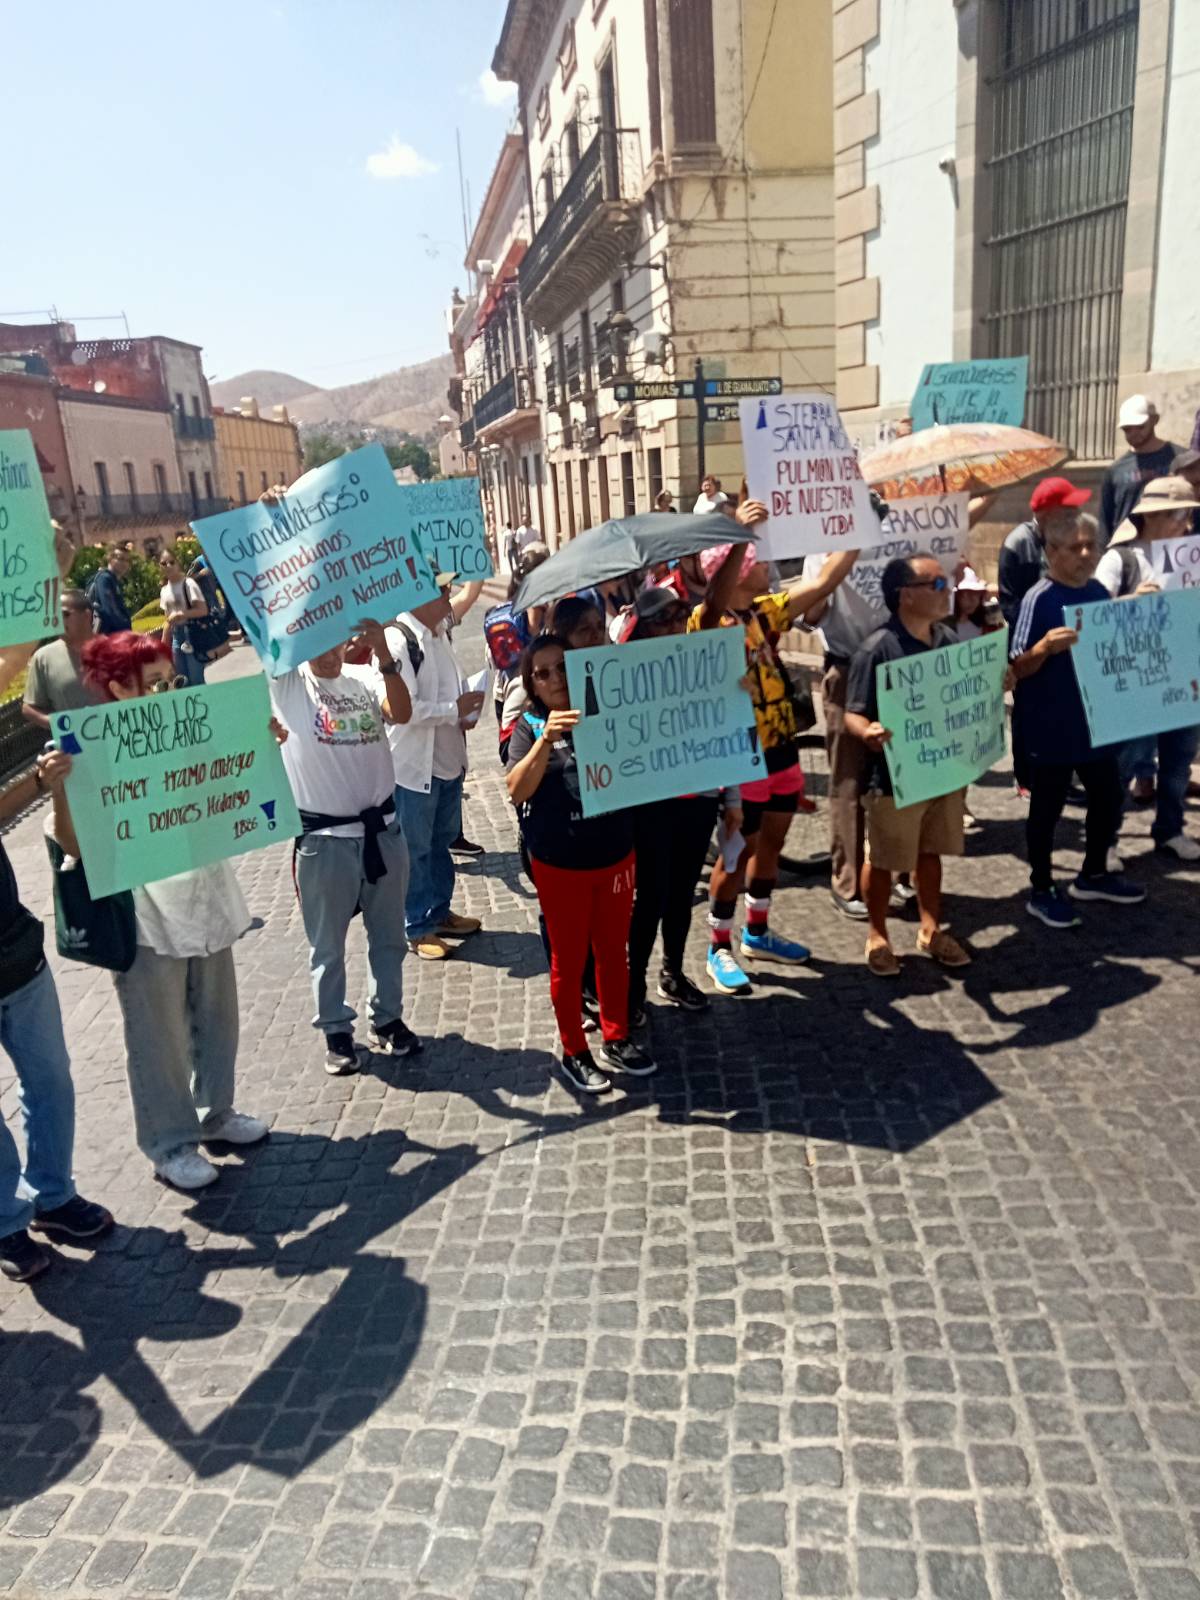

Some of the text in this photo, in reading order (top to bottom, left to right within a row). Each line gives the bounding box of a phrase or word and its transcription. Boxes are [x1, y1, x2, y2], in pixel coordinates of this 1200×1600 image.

[634, 384, 674, 398] MOMIAS
[773, 424, 821, 452] SANTA
[771, 485, 855, 517] DE NUESTRA
[418, 518, 474, 542] MINO
[821, 513, 855, 536] VIDA
[350, 535, 406, 575] nuestro
[172, 694, 209, 724] LOS
[586, 763, 614, 793] NO
[618, 754, 646, 777] es
[649, 744, 681, 772] una
[149, 804, 201, 834] Dolores
